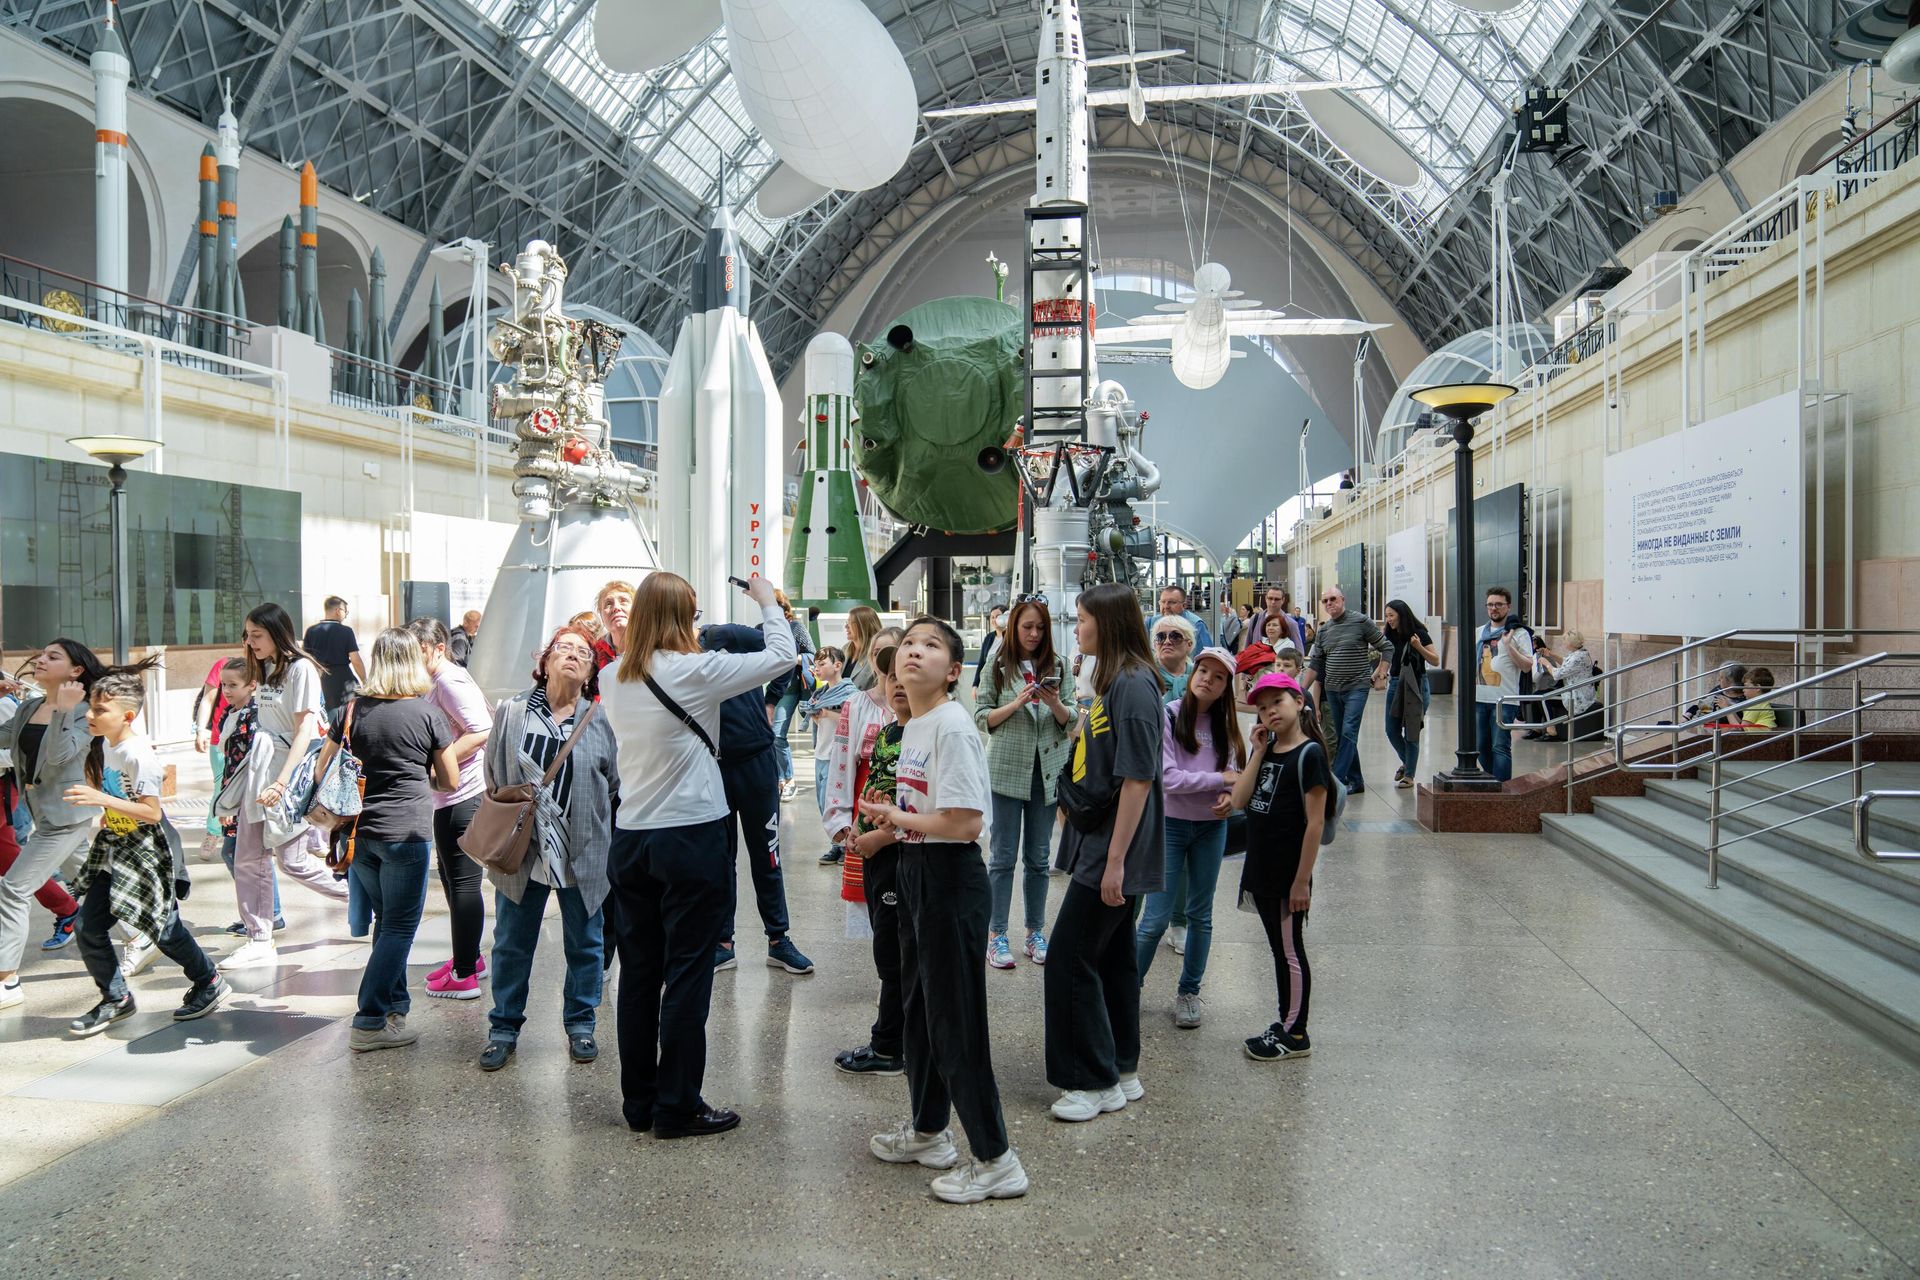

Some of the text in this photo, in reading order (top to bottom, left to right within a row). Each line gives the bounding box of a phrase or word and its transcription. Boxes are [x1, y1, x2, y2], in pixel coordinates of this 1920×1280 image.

[725, 256, 734, 291] СССР
[1638, 526, 1741, 550] НИКОГДА НЕ ВИДАННЫЕ С ЗЕМЛИ
